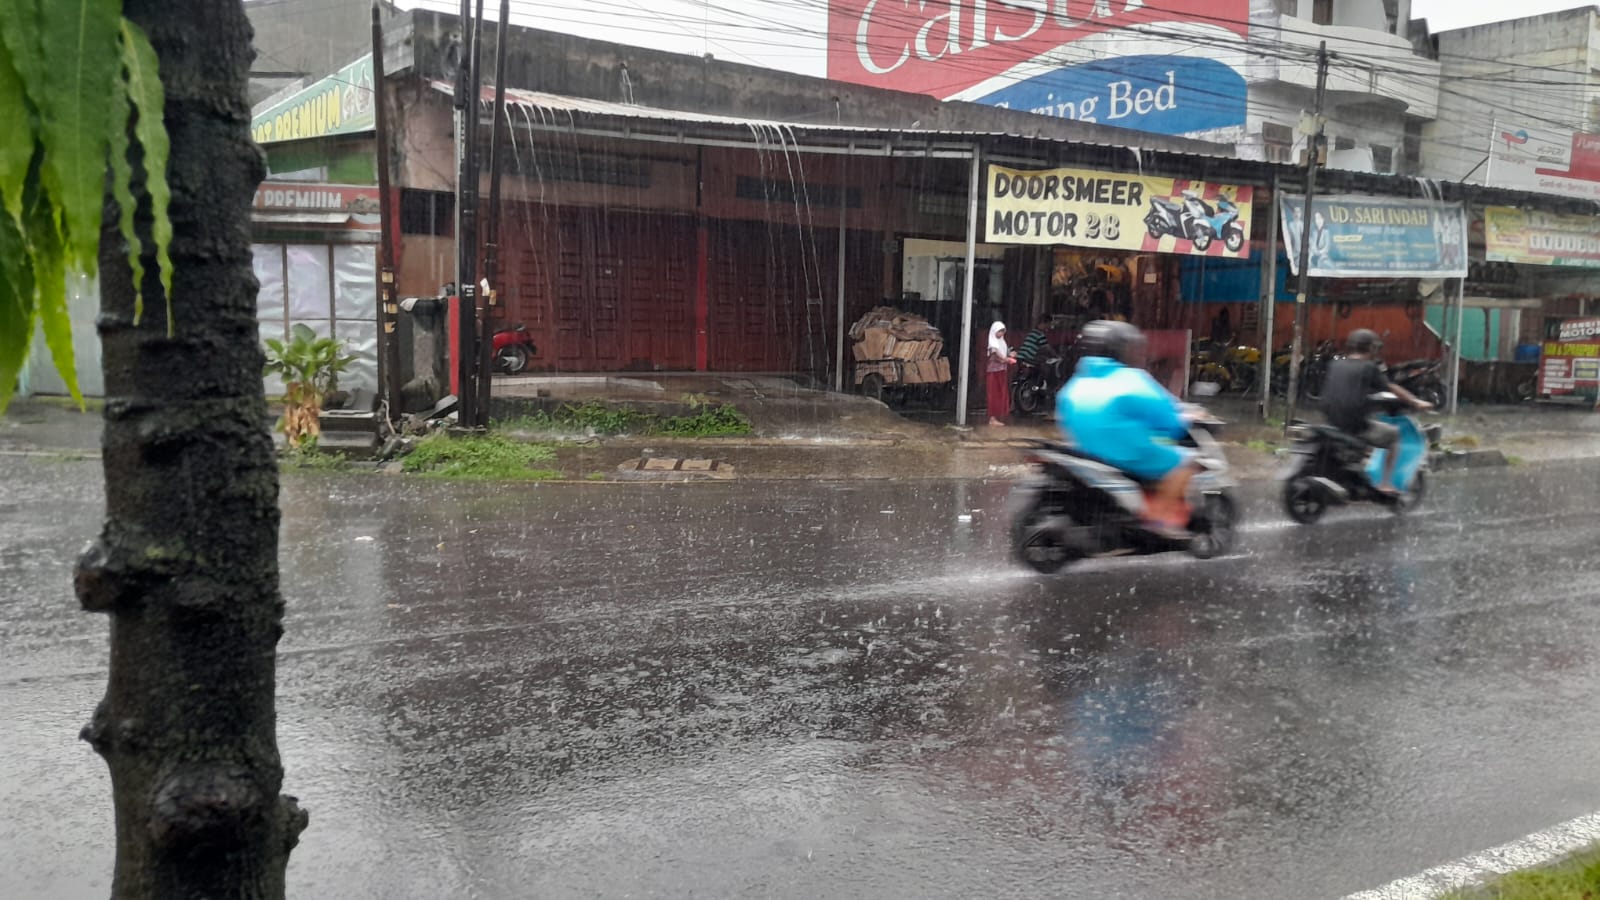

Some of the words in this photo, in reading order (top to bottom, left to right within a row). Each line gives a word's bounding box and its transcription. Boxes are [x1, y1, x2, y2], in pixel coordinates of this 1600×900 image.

[1107, 70, 1177, 120] Bed
[275, 84, 340, 141] PREMIUM
[263, 189, 342, 208] PREMIUM
[994, 173, 1144, 206] DOORSMEER
[992, 209, 1078, 238] MOTOR
[1085, 212, 1120, 240] 28
[1328, 205, 1353, 223] UD.
[1355, 207, 1385, 224] SARI
[1387, 208, 1428, 225] INDAH
